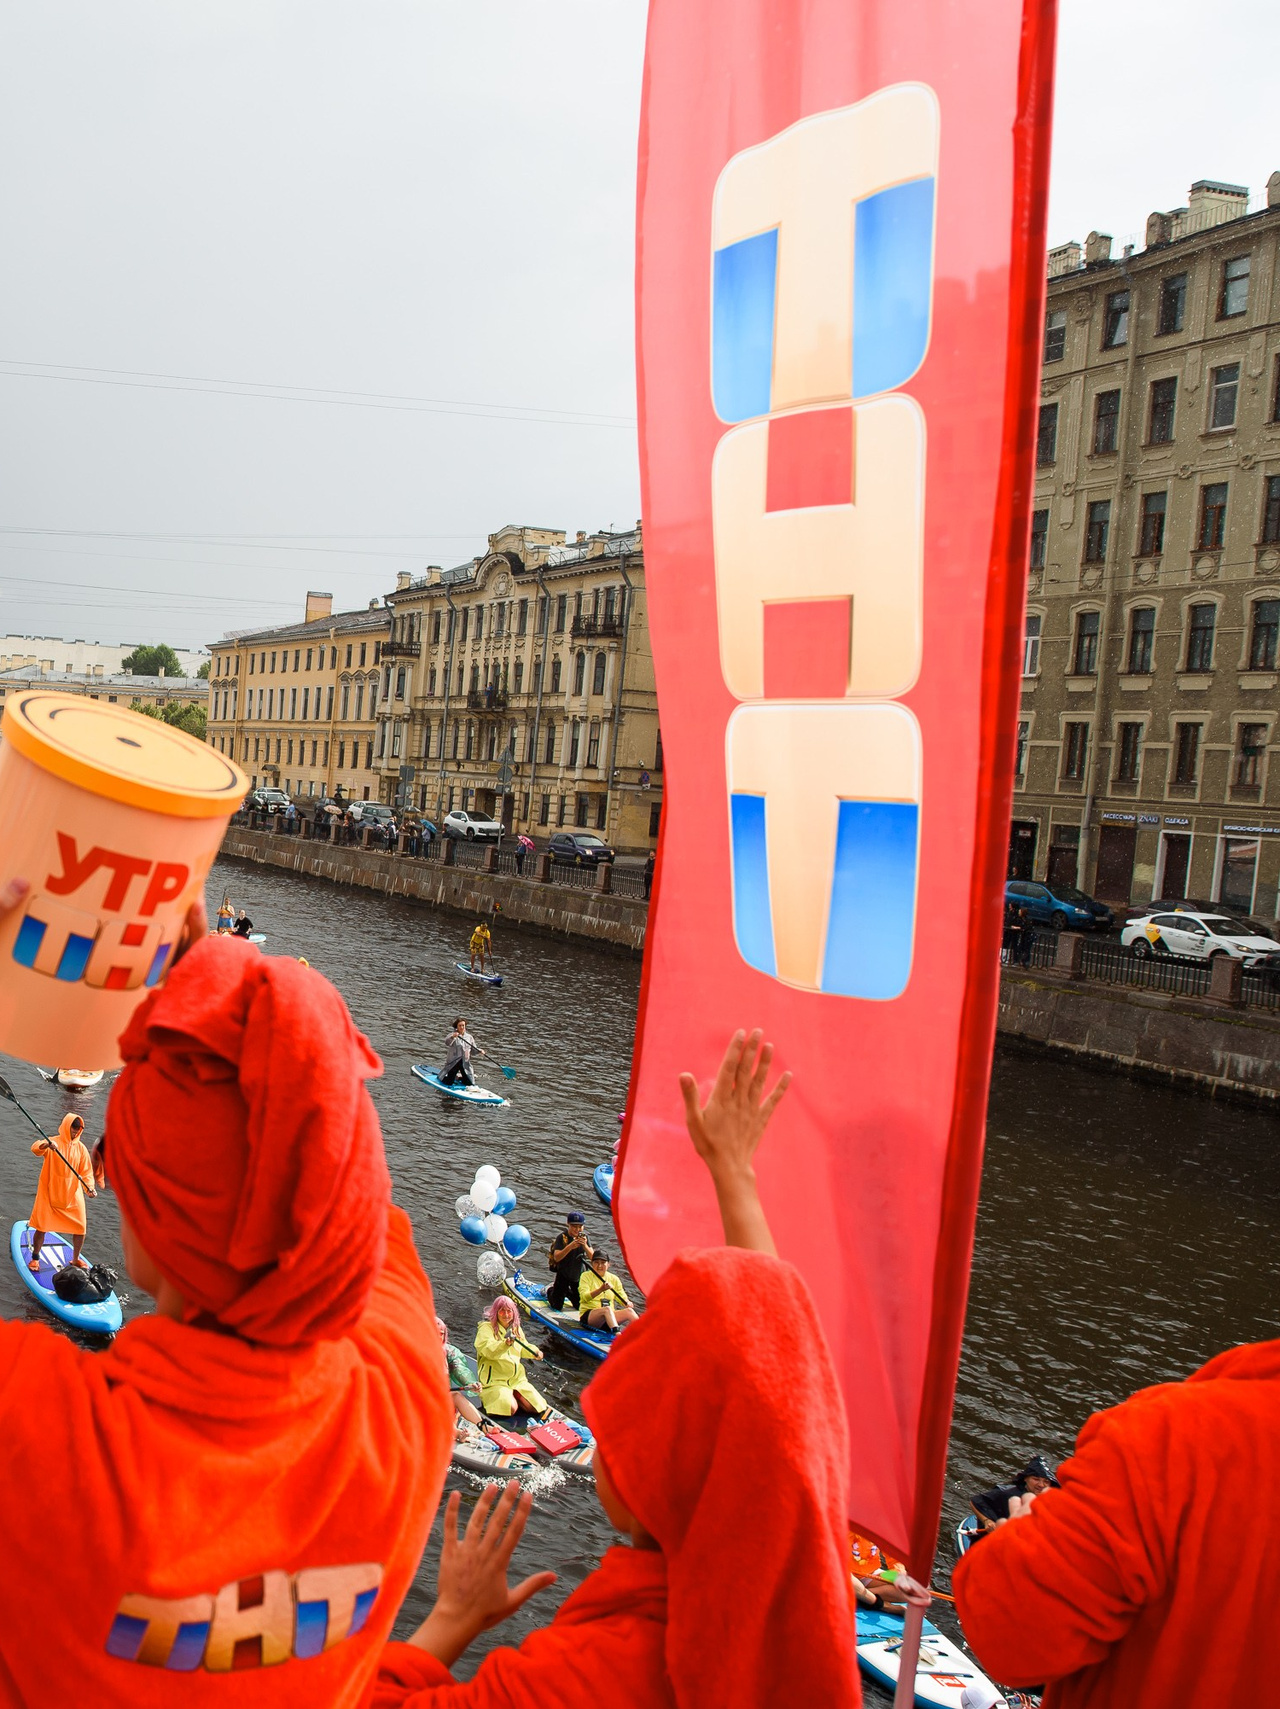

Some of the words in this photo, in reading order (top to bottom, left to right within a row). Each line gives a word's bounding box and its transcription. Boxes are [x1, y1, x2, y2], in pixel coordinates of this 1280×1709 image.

[711, 80, 940, 1001] ТНТ
[1164, 817, 1189, 825] ОДЕЖДА
[543, 1426, 568, 1444] AVON
[105, 1562, 384, 1674] ТНТ
